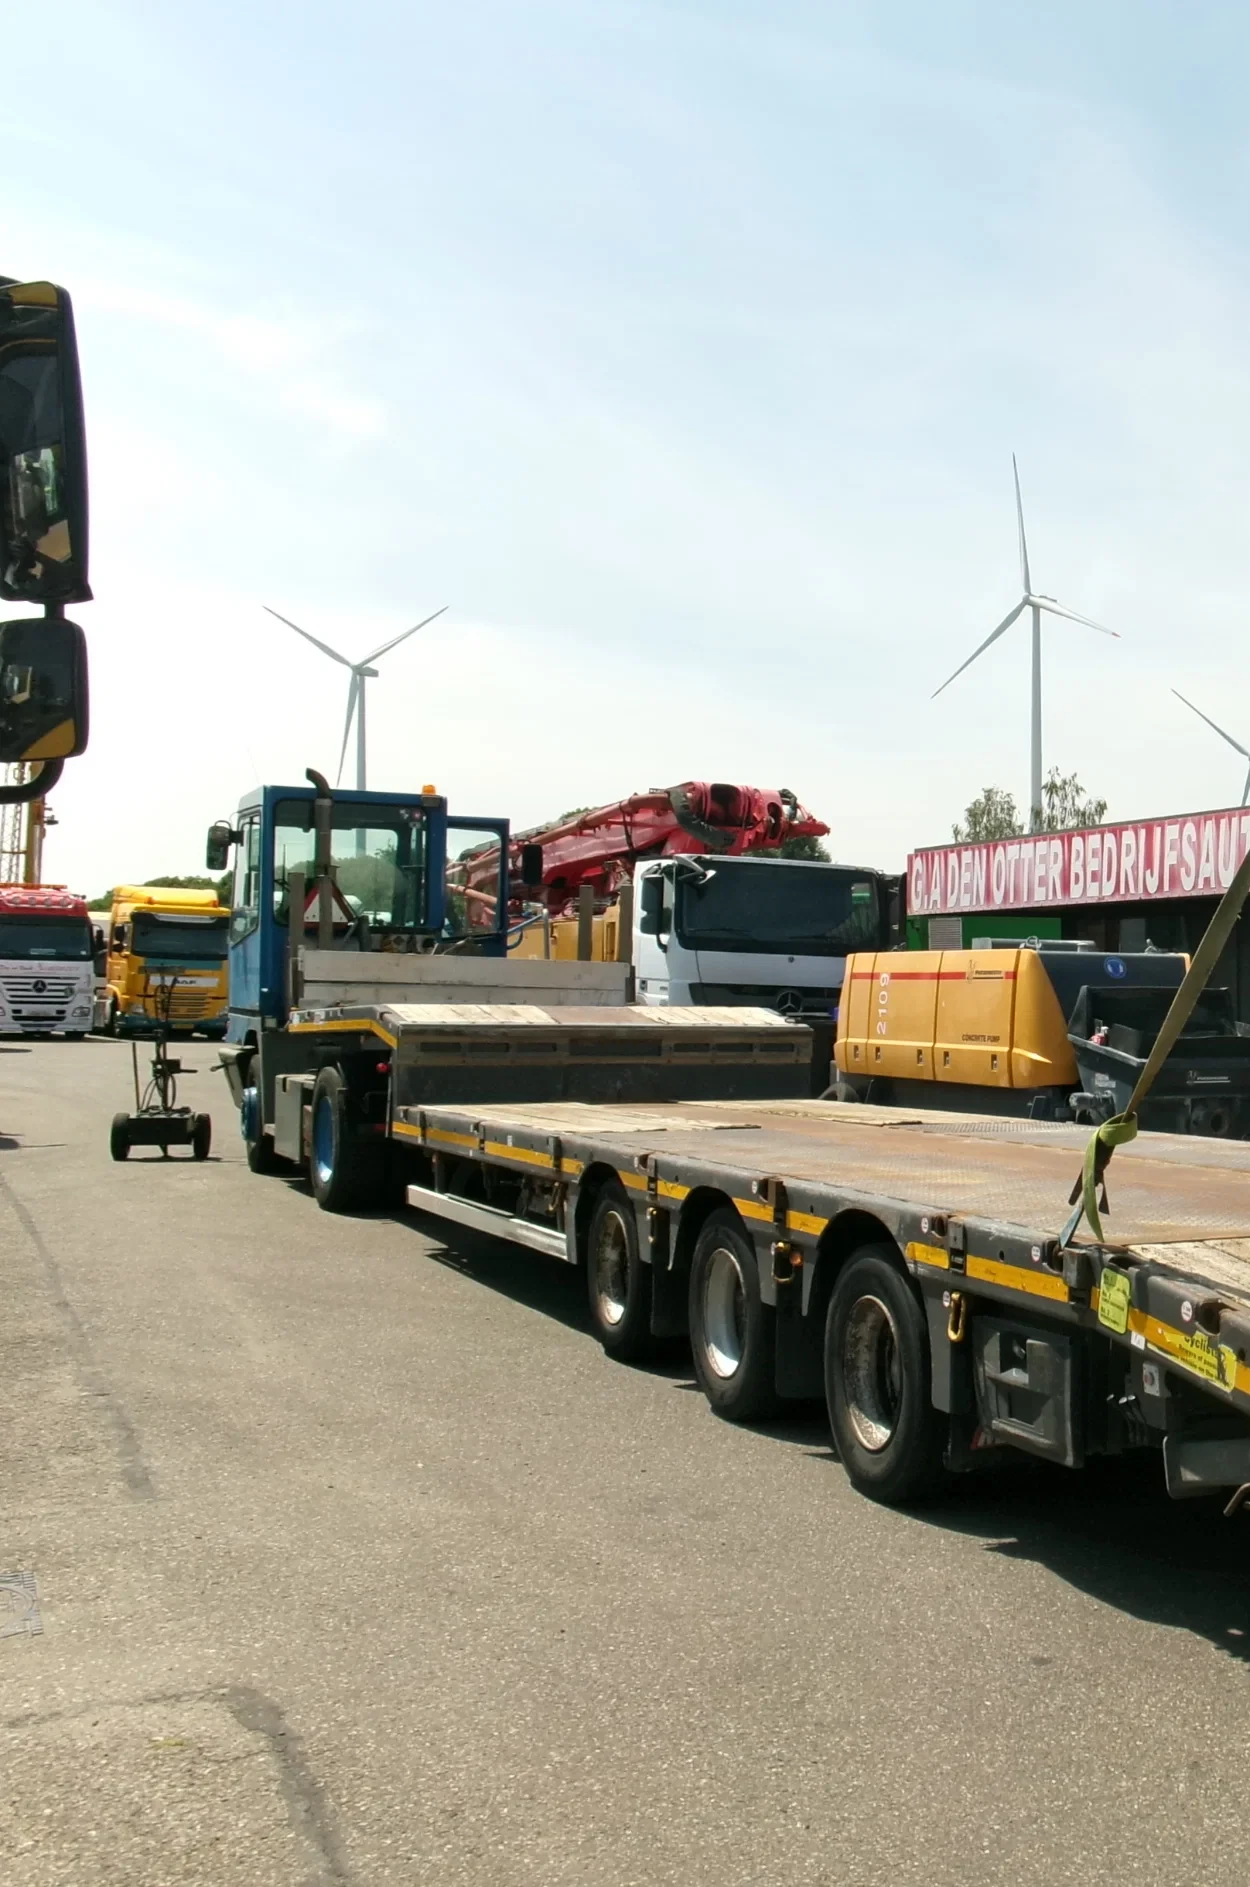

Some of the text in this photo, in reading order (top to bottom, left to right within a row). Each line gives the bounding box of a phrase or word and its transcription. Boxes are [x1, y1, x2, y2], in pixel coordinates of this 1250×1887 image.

[947, 848, 987, 908] DEN
[993, 839, 1064, 905] OTTER
[876, 972, 890, 1036] 2109
[987, 1035, 1000, 1043] PUMP
